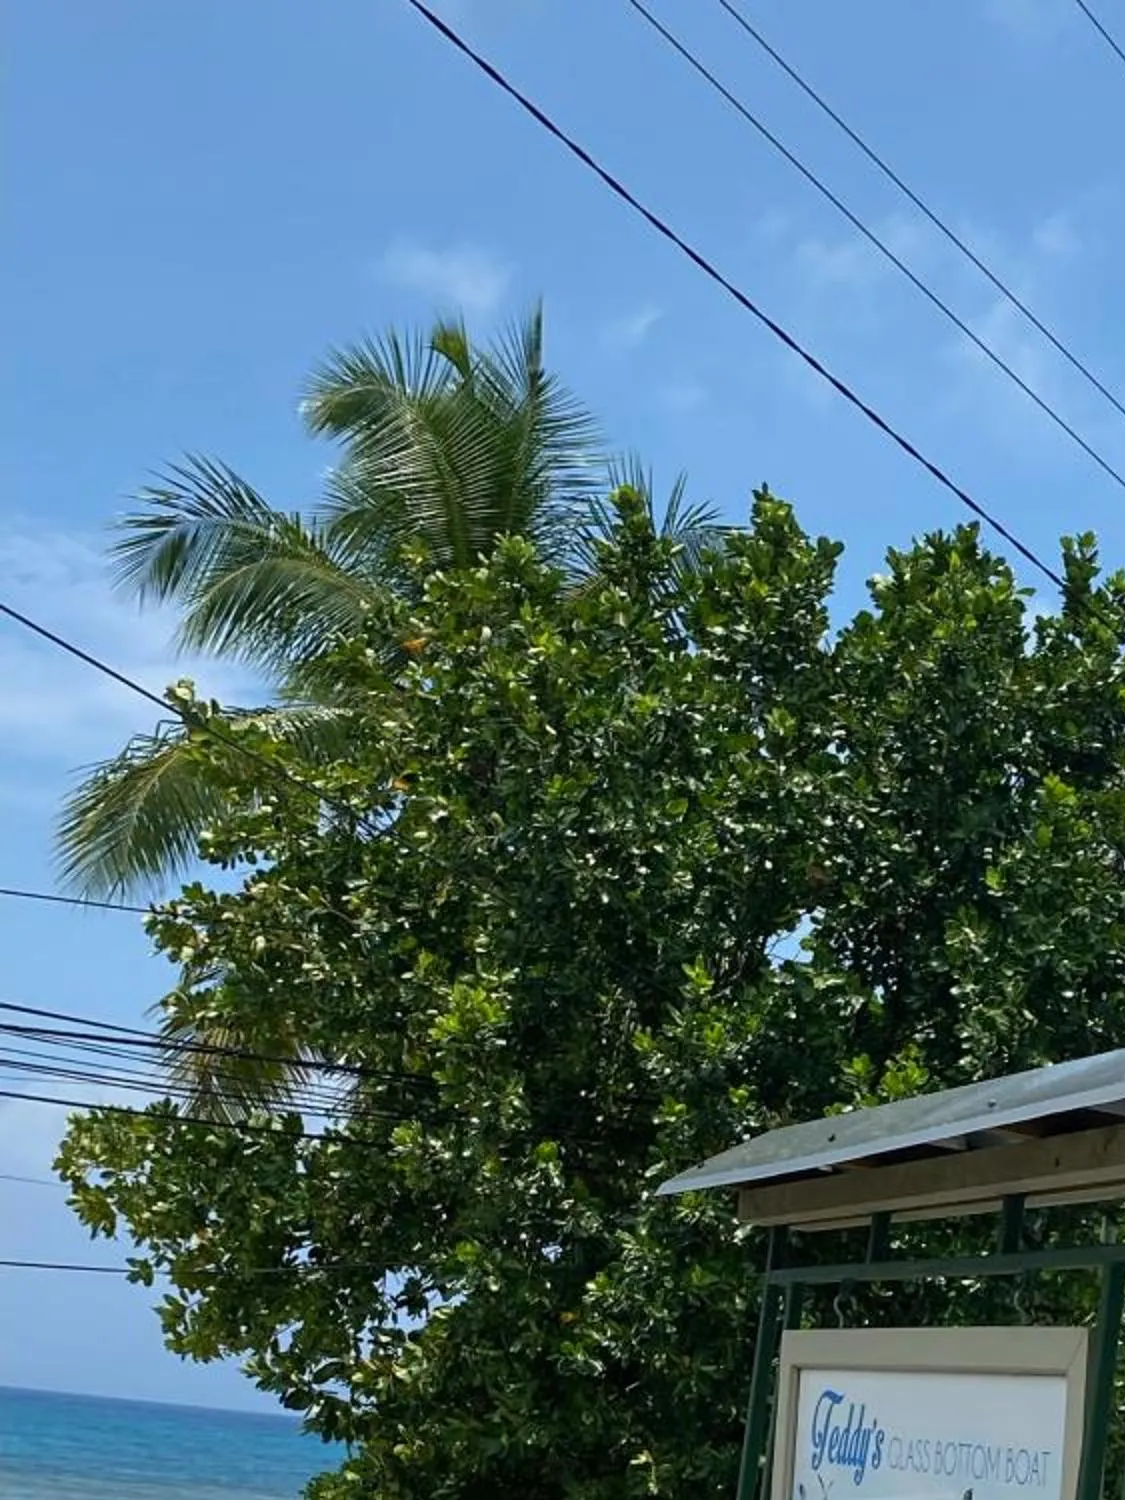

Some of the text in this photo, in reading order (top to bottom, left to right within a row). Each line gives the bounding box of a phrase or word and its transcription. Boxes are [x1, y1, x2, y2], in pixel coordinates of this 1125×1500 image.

[811, 1390, 1052, 1487] Teddy's GLASS BOTTOM BOAT
